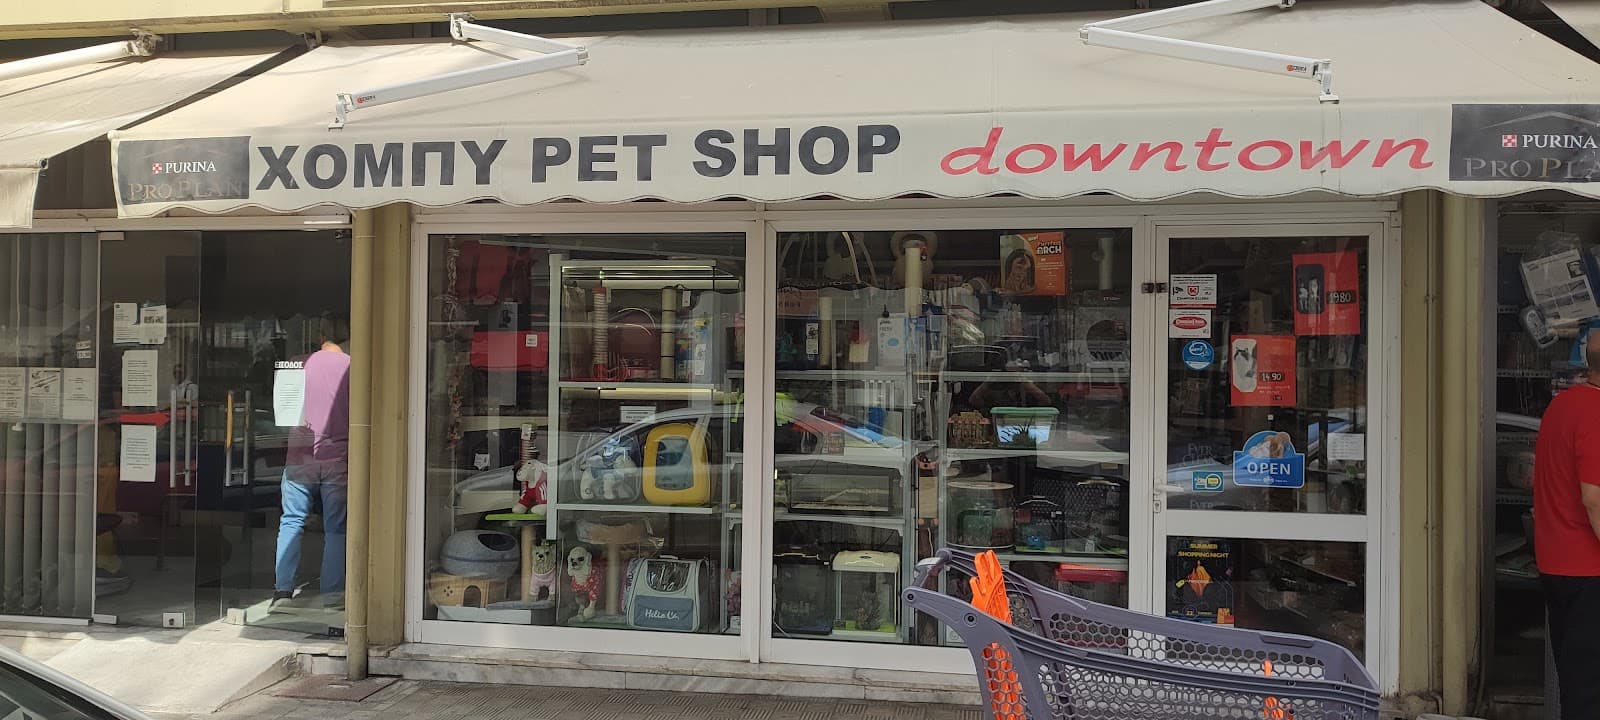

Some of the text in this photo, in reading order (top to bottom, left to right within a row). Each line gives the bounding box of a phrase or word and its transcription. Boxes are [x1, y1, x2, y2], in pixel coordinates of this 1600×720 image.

[1521, 134, 1599, 148] PURINA
[256, 124, 1434, 190] ΧΟΜΠΥ PET SHOP downtown
[164, 160, 217, 174] PURINA
[1463, 158, 1532, 178] PRO
[1246, 461, 1291, 475] OPEN
